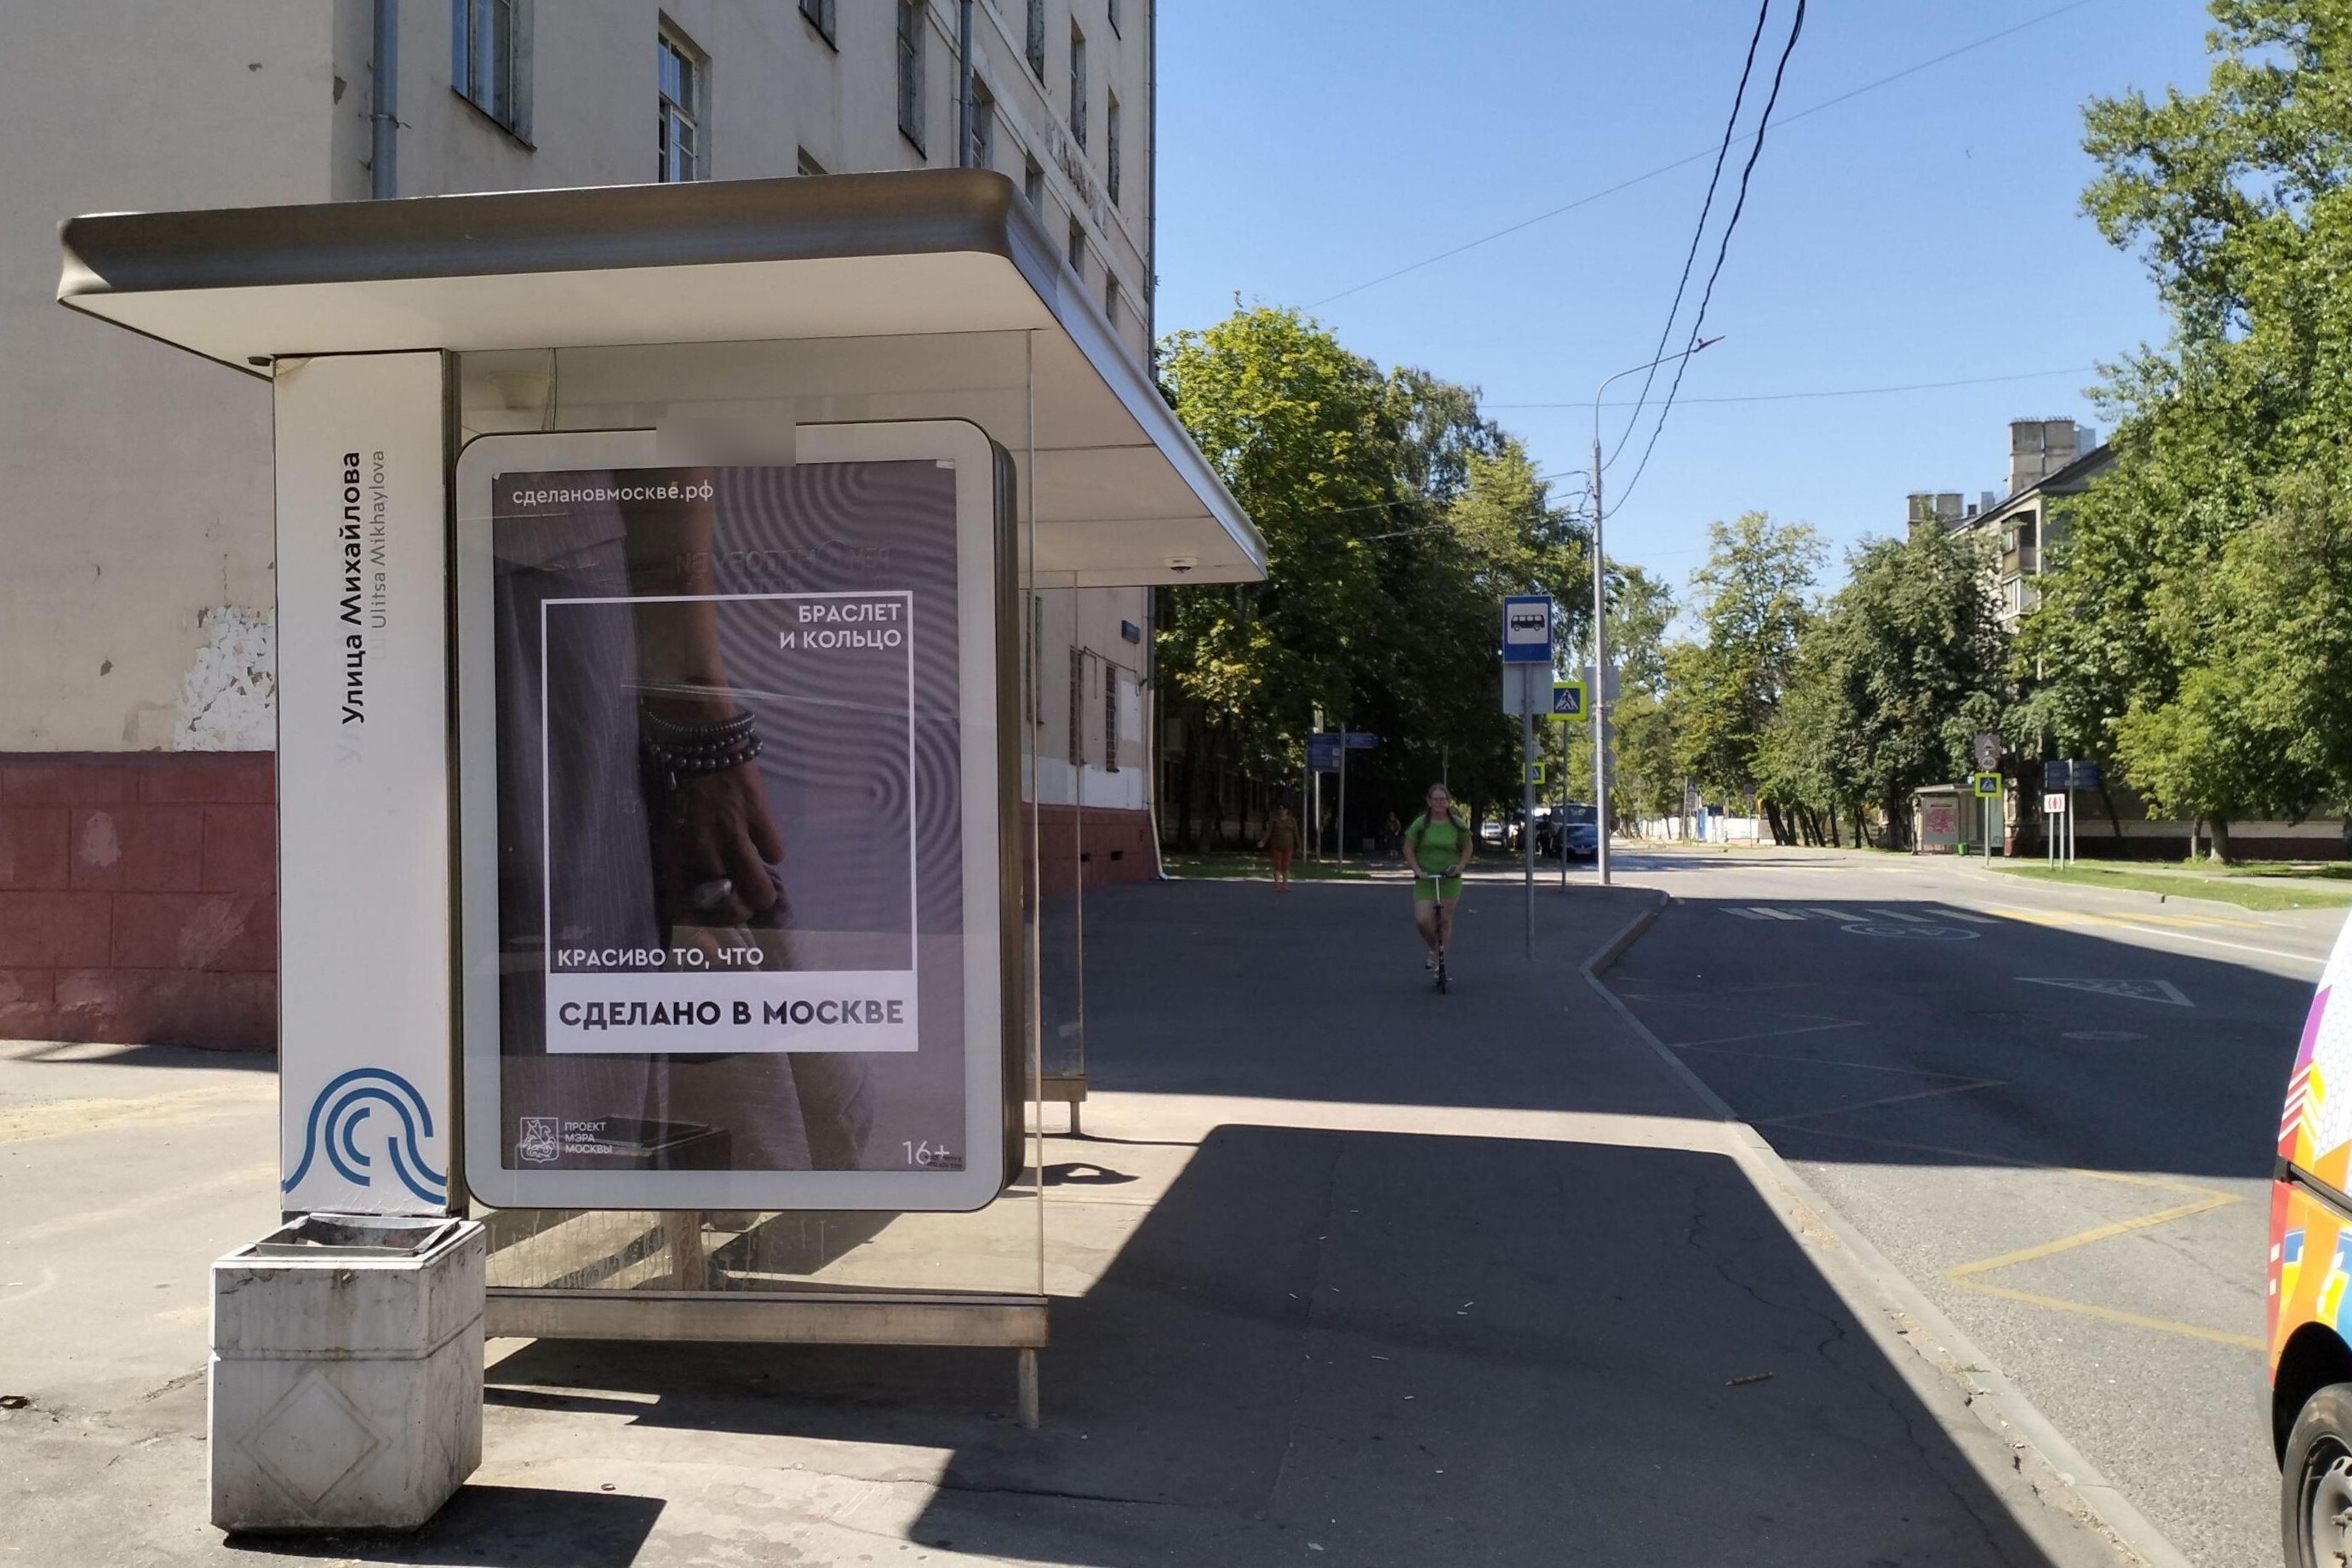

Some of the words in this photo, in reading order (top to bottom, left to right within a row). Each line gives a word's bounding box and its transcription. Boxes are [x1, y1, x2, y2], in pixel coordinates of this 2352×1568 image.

[512, 479, 714, 506] сделановмоскве.рф
[369, 450, 388, 566] Mikhaylova
[339, 451, 363, 626] Михайлова
[371, 571, 386, 629] Ulitsa
[798, 604, 902, 623] БРАСЛЕТ
[780, 631, 795, 650] И
[803, 629, 902, 650] КОЛЬЦО
[341, 634, 366, 724] Улица
[558, 948, 667, 967] КРАСИВО
[672, 947, 711, 970] ТО,
[717, 947, 764, 966] ЧТО
[558, 1000, 721, 1031] СДЕЛАНО
[733, 1001, 753, 1025] В
[763, 999, 904, 1025] МОСКВЕ
[564, 1121, 607, 1132] ПРОЕКТ
[564, 1133, 596, 1142] МЭРА
[565, 1143, 613, 1154] МОСКВЫ
[902, 1140, 951, 1165] 16+
